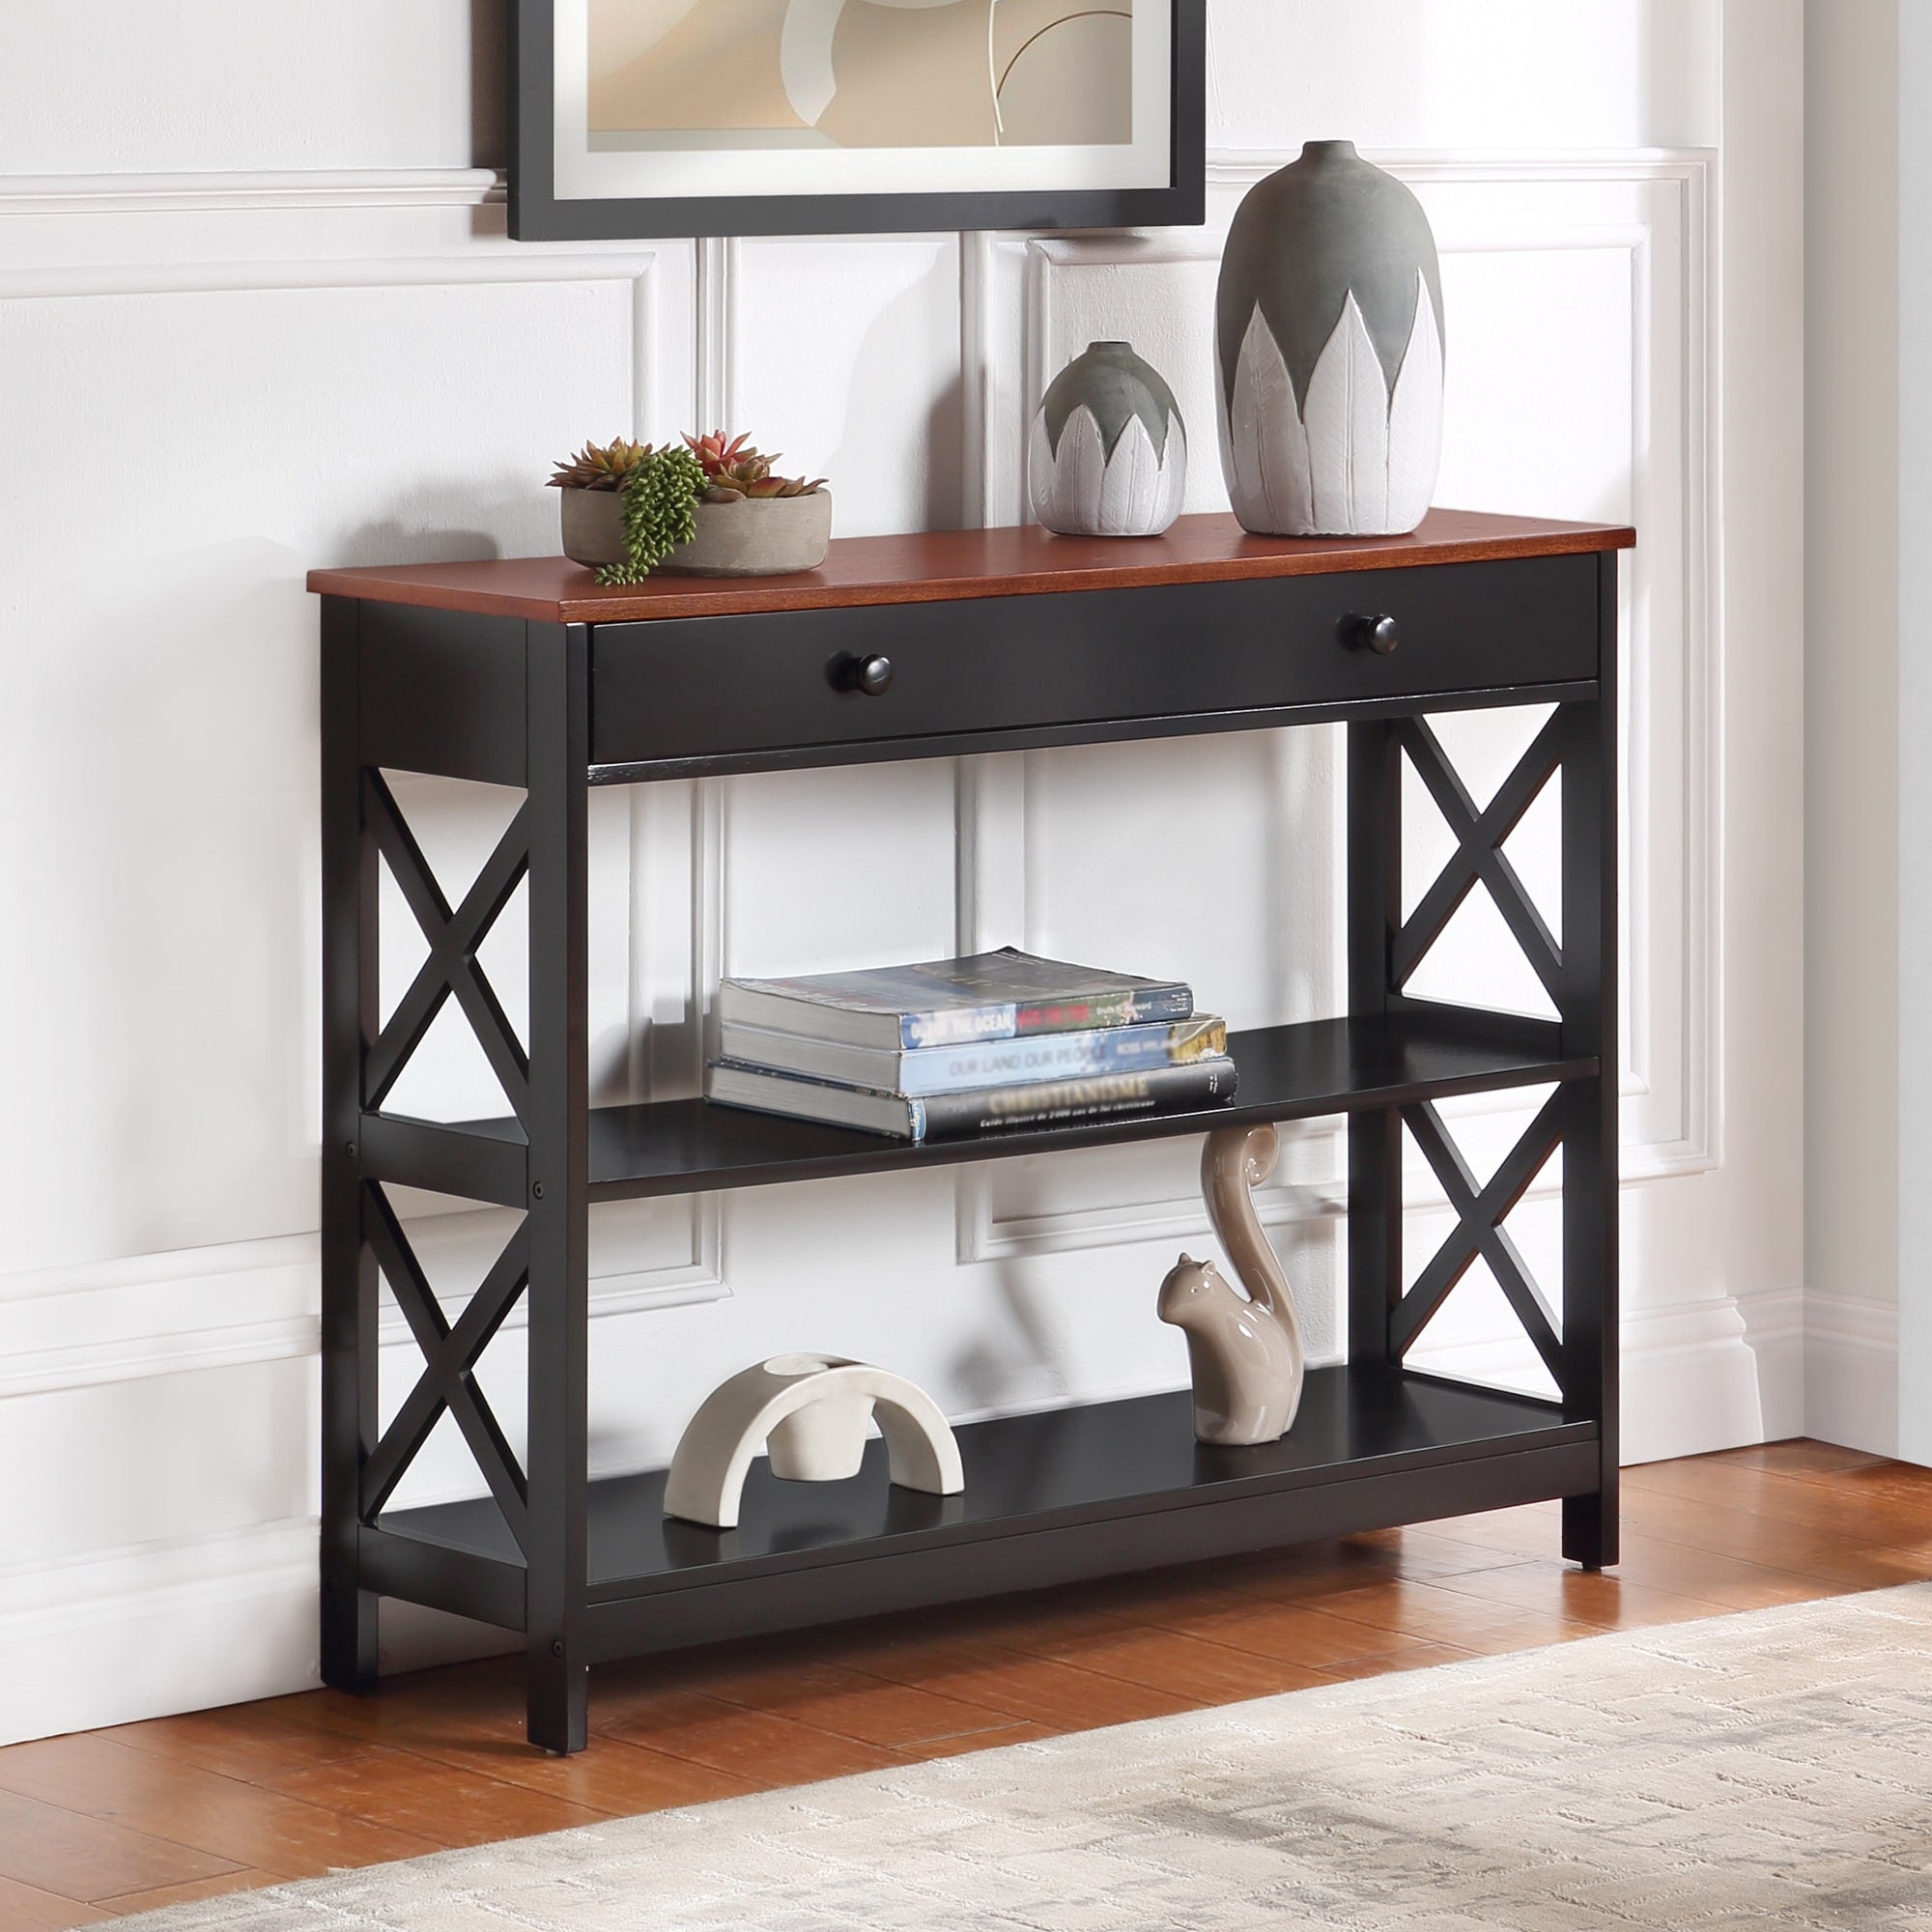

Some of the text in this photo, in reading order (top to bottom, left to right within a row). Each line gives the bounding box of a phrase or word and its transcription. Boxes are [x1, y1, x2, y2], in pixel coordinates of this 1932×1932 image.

[974, 1012, 1011, 1033] OCEAN
[950, 1060, 978, 1077] OUR
[982, 1055, 1021, 1072] LAND
[1025, 1050, 1053, 1068] OUR
[988, 1077, 1150, 1115] CHRISTIANISME
